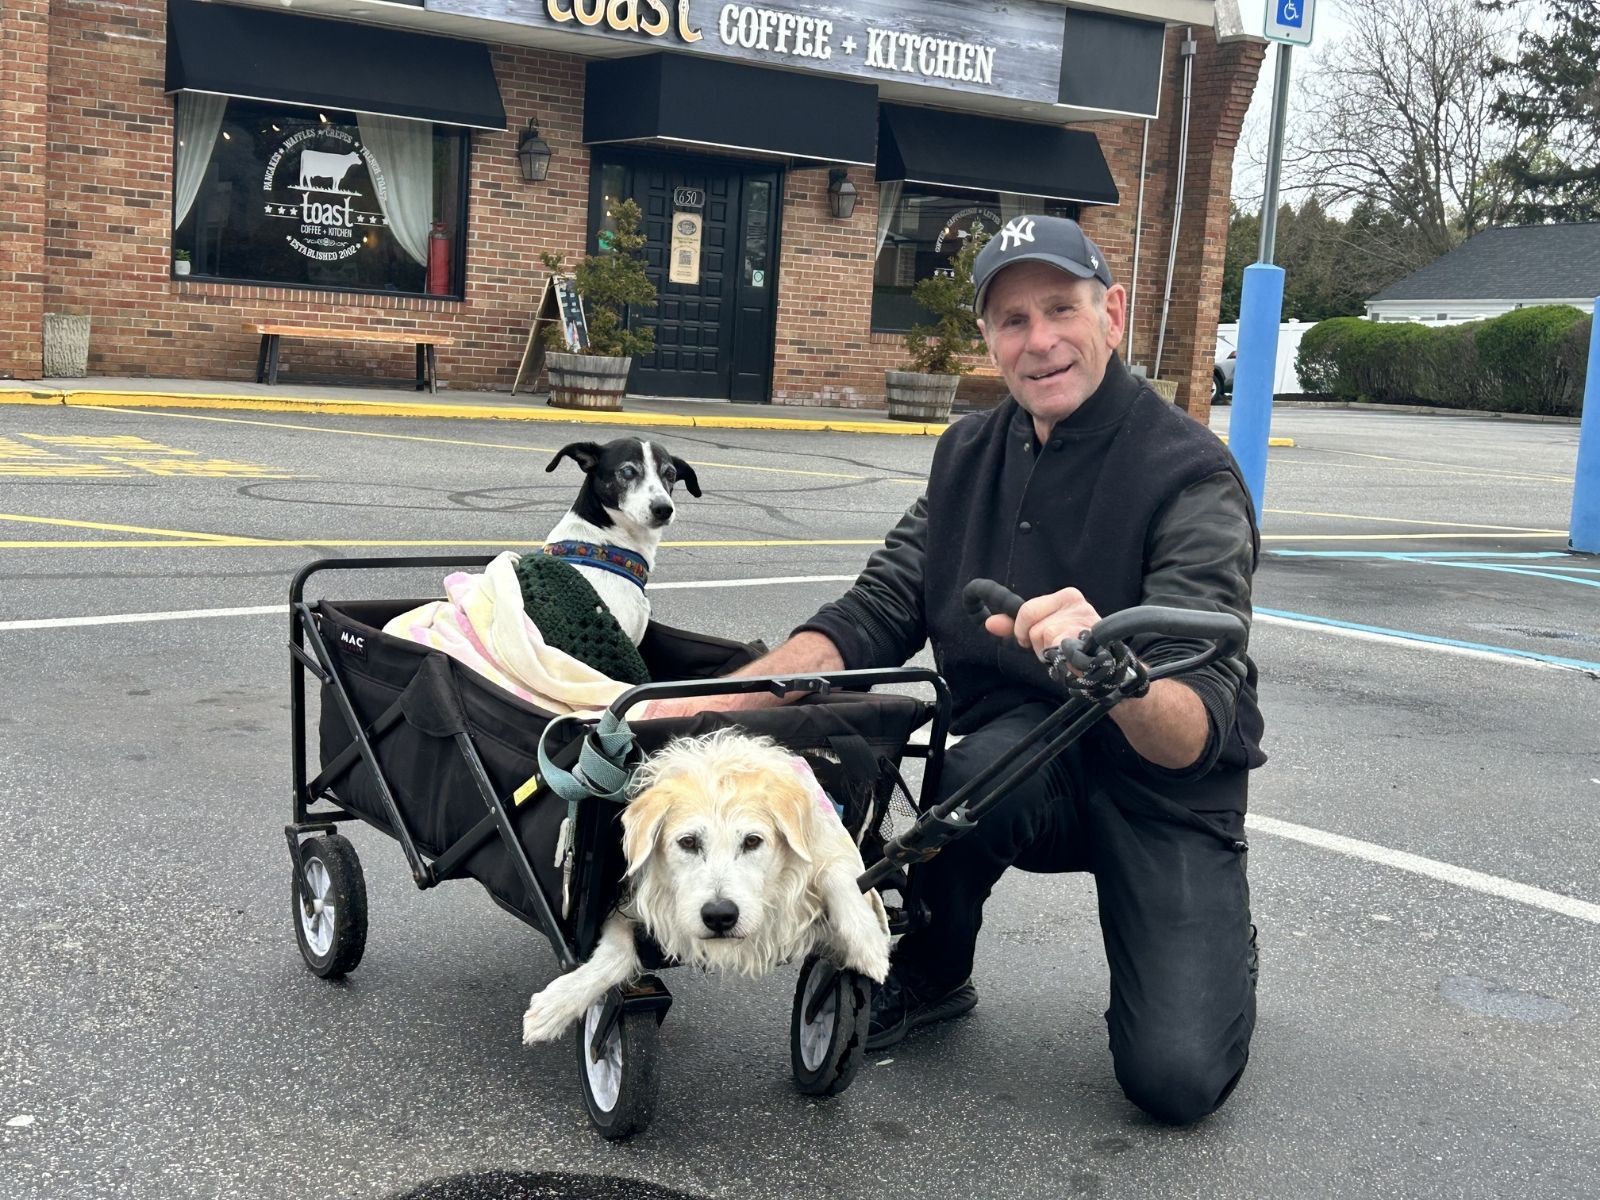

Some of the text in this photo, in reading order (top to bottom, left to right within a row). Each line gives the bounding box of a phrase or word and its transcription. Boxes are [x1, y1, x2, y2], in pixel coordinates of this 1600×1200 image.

[547, 0, 996, 85] oast COFFEE + KITCHEN
[263, 152, 282, 191] PANCAKES
[283, 128, 316, 150] WAFFLES
[360, 145, 382, 175] FRENCH
[300, 191, 354, 227] toast
[678, 190, 697, 205] 650
[301, 224, 321, 235] COFFEE
[328, 228, 352, 238] KITCHEN
[1000, 216, 1035, 251] NY
[289, 238, 357, 261] ESTABLISHED 2002
[341, 631, 365, 648] MAC
